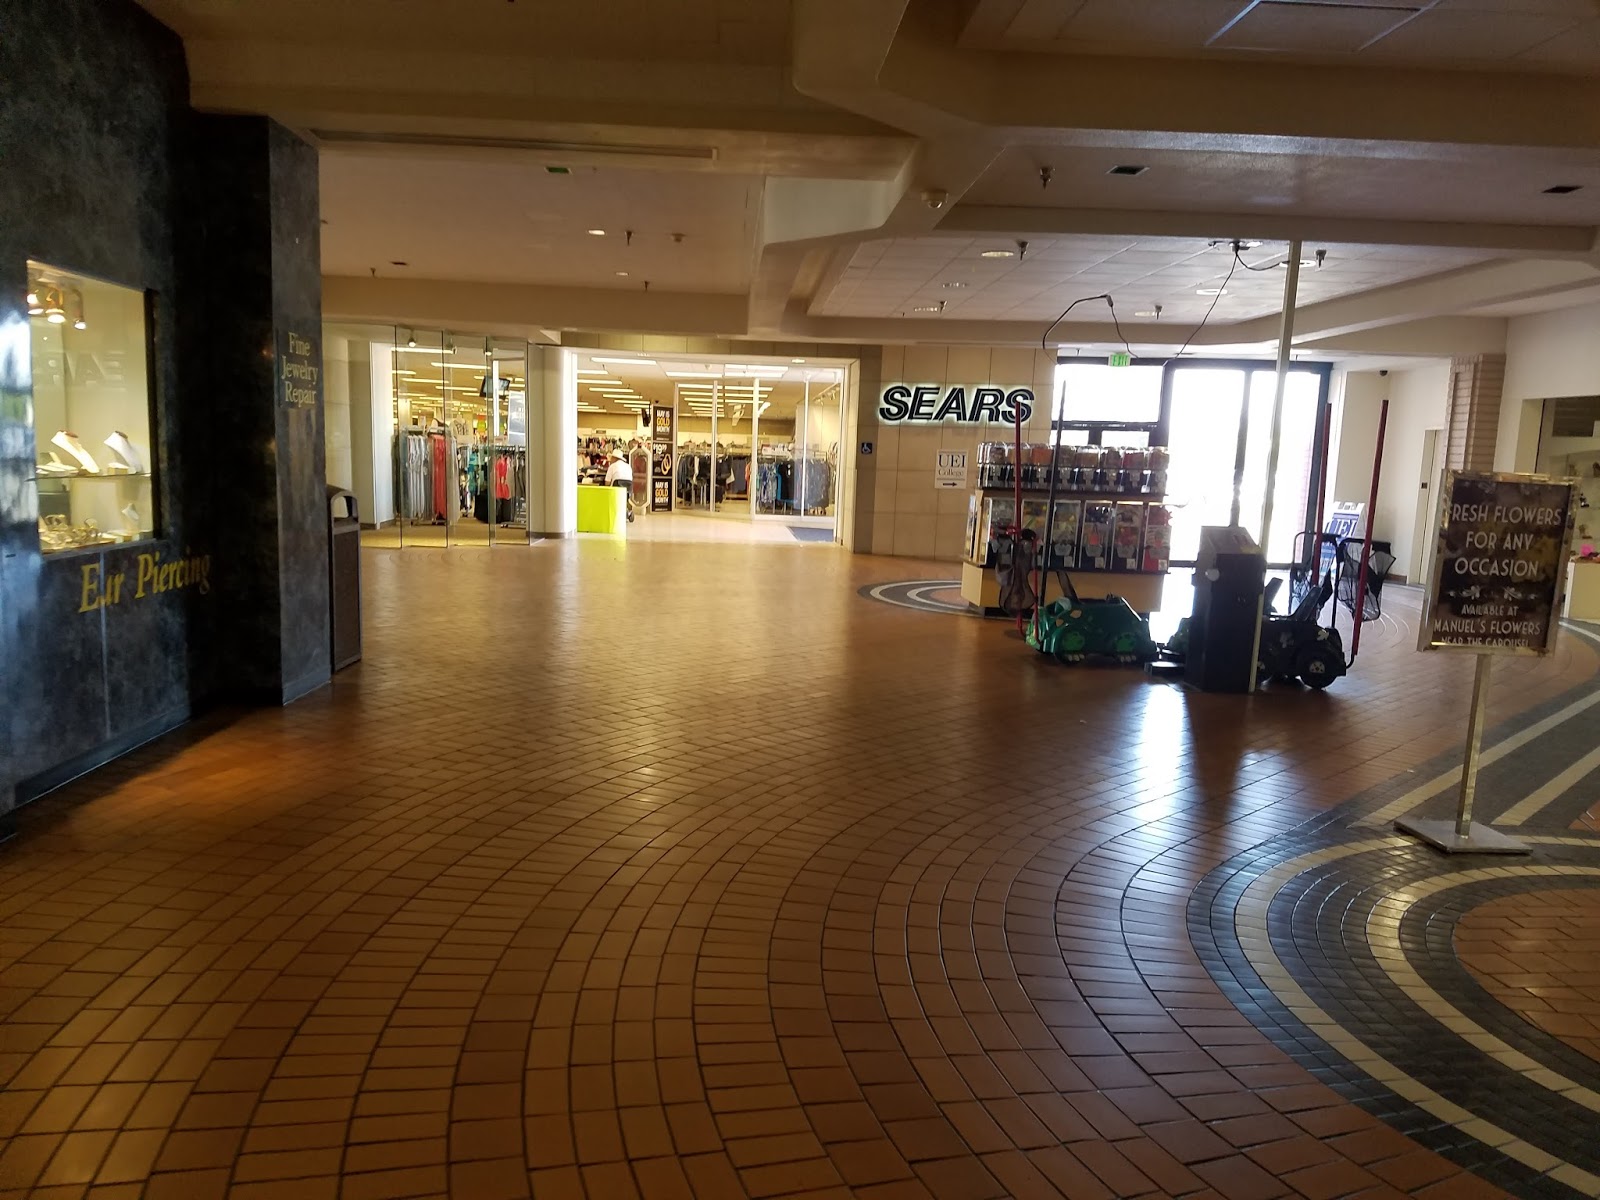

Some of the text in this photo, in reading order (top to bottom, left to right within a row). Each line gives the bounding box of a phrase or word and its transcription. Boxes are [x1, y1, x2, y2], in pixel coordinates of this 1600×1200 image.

[288, 331, 310, 356] Fine
[281, 355, 319, 385] Jewelry
[285, 381, 317, 408] Repair
[879, 385, 1035, 424] SEARS
[656, 417, 670, 426] GOLD
[938, 454, 966, 468] UEI
[655, 488, 668, 497] GOLD
[1450, 503, 1563, 526] RESH FLOWERS
[1466, 531, 1534, 550] FOR ANY
[134, 546, 210, 598] Piercing
[1454, 557, 1539, 577] OCCASION
[1461, 604, 1519, 618] AVAILABLE AT
[1434, 618, 1541, 636] MANUEL'S FLOWERS
